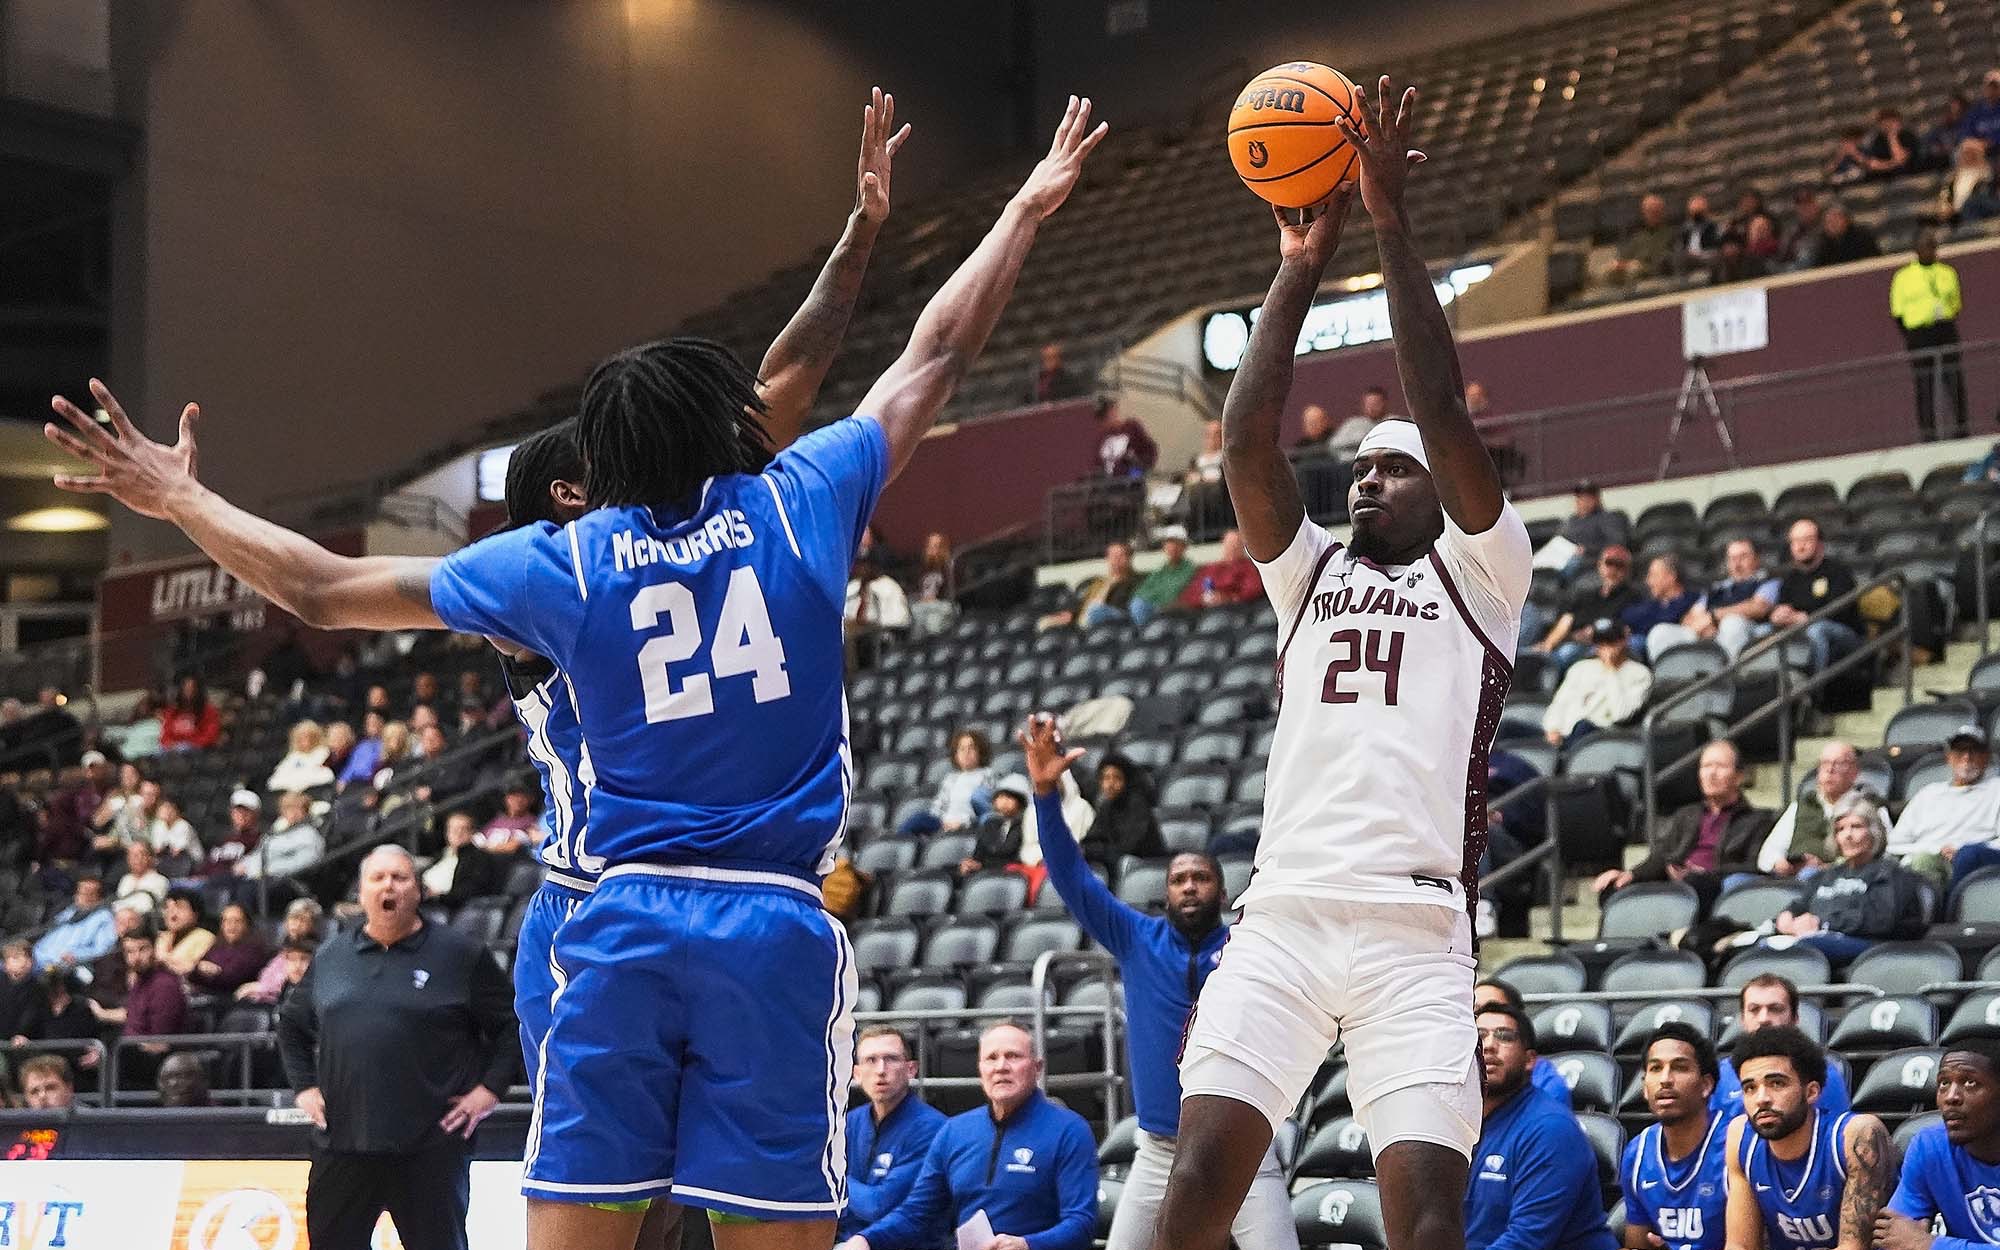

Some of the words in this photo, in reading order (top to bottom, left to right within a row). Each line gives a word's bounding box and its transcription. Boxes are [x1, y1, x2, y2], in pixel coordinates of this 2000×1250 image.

[1234, 88, 1305, 113] Wil
[612, 509, 755, 572] McMORRIS
[1312, 586, 1440, 625] TROJANS
[630, 565, 791, 724] 24
[1321, 628, 1405, 706] 24
[1658, 1207, 1704, 1239] EIU
[1777, 1213, 1834, 1242] EIU
